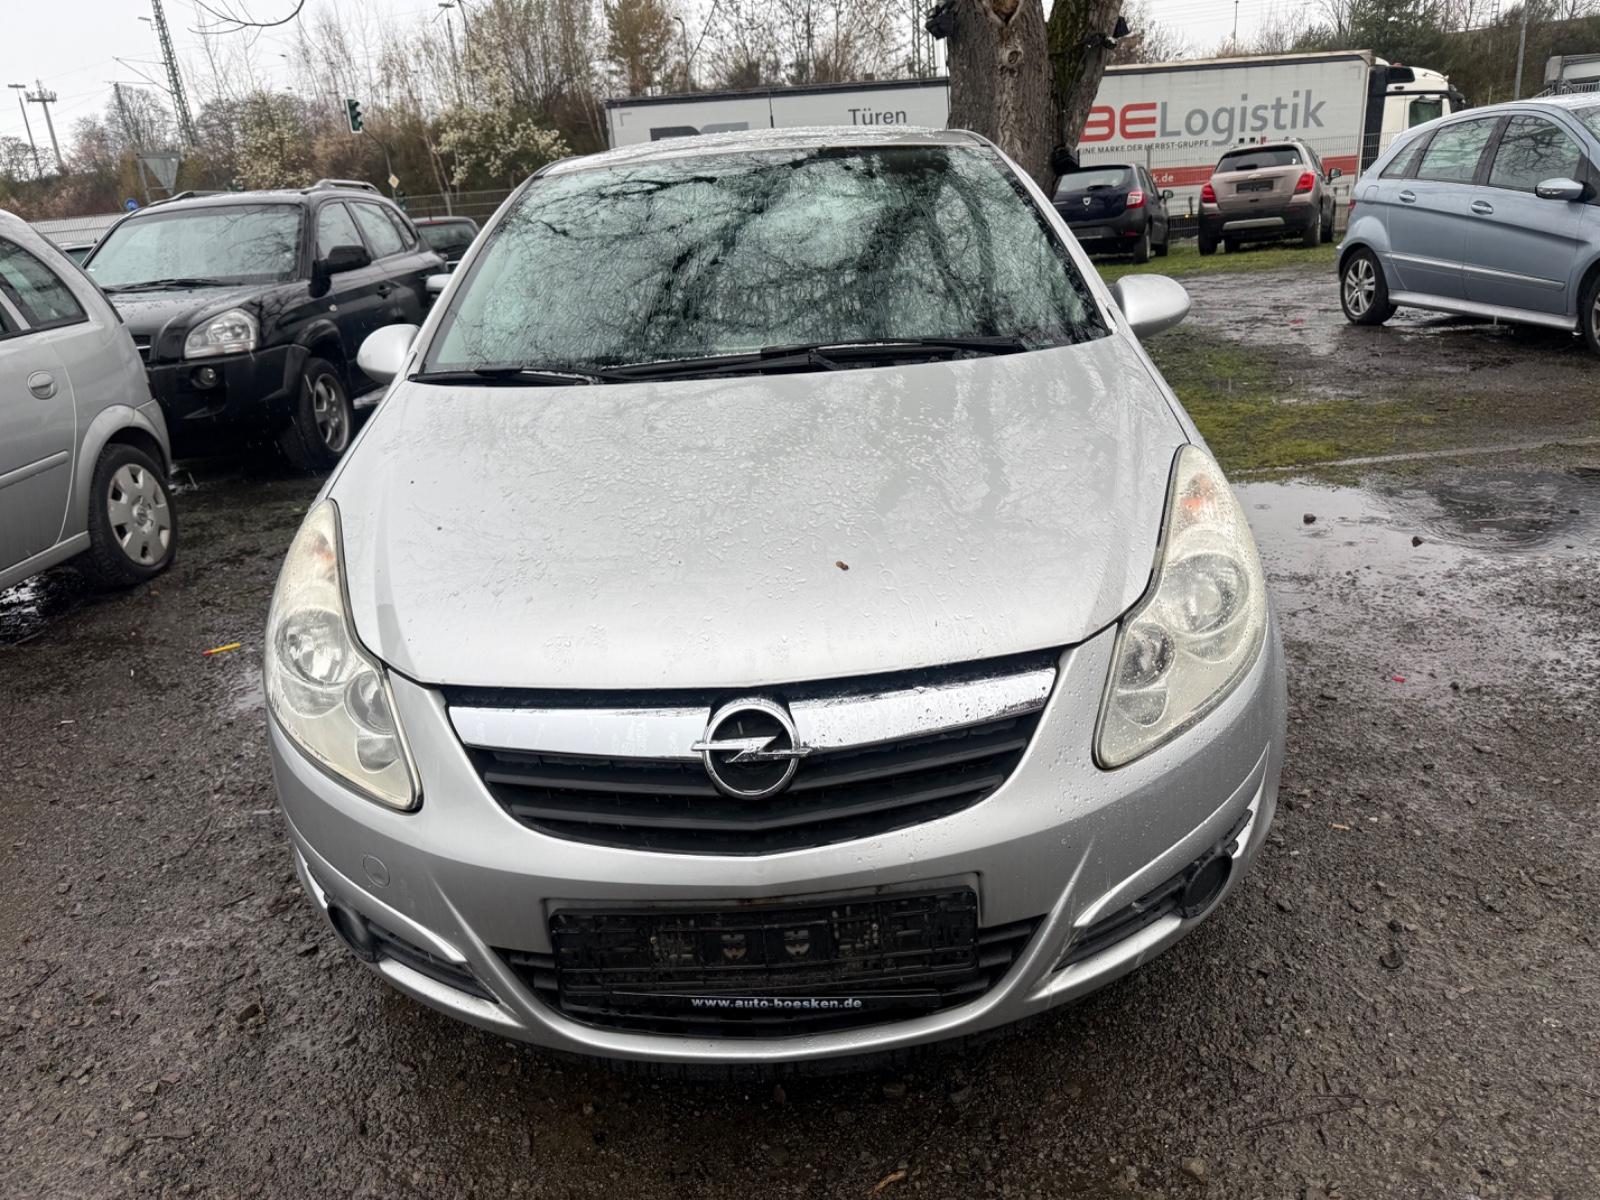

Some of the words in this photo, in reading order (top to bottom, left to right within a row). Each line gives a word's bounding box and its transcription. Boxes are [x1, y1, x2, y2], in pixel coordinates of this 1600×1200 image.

[848, 108, 907, 126] Türen
[1098, 144, 1126, 153] MARKE
[1127, 143, 1142, 152] DER
[690, 997, 863, 1009] www.auto-boesken.de
